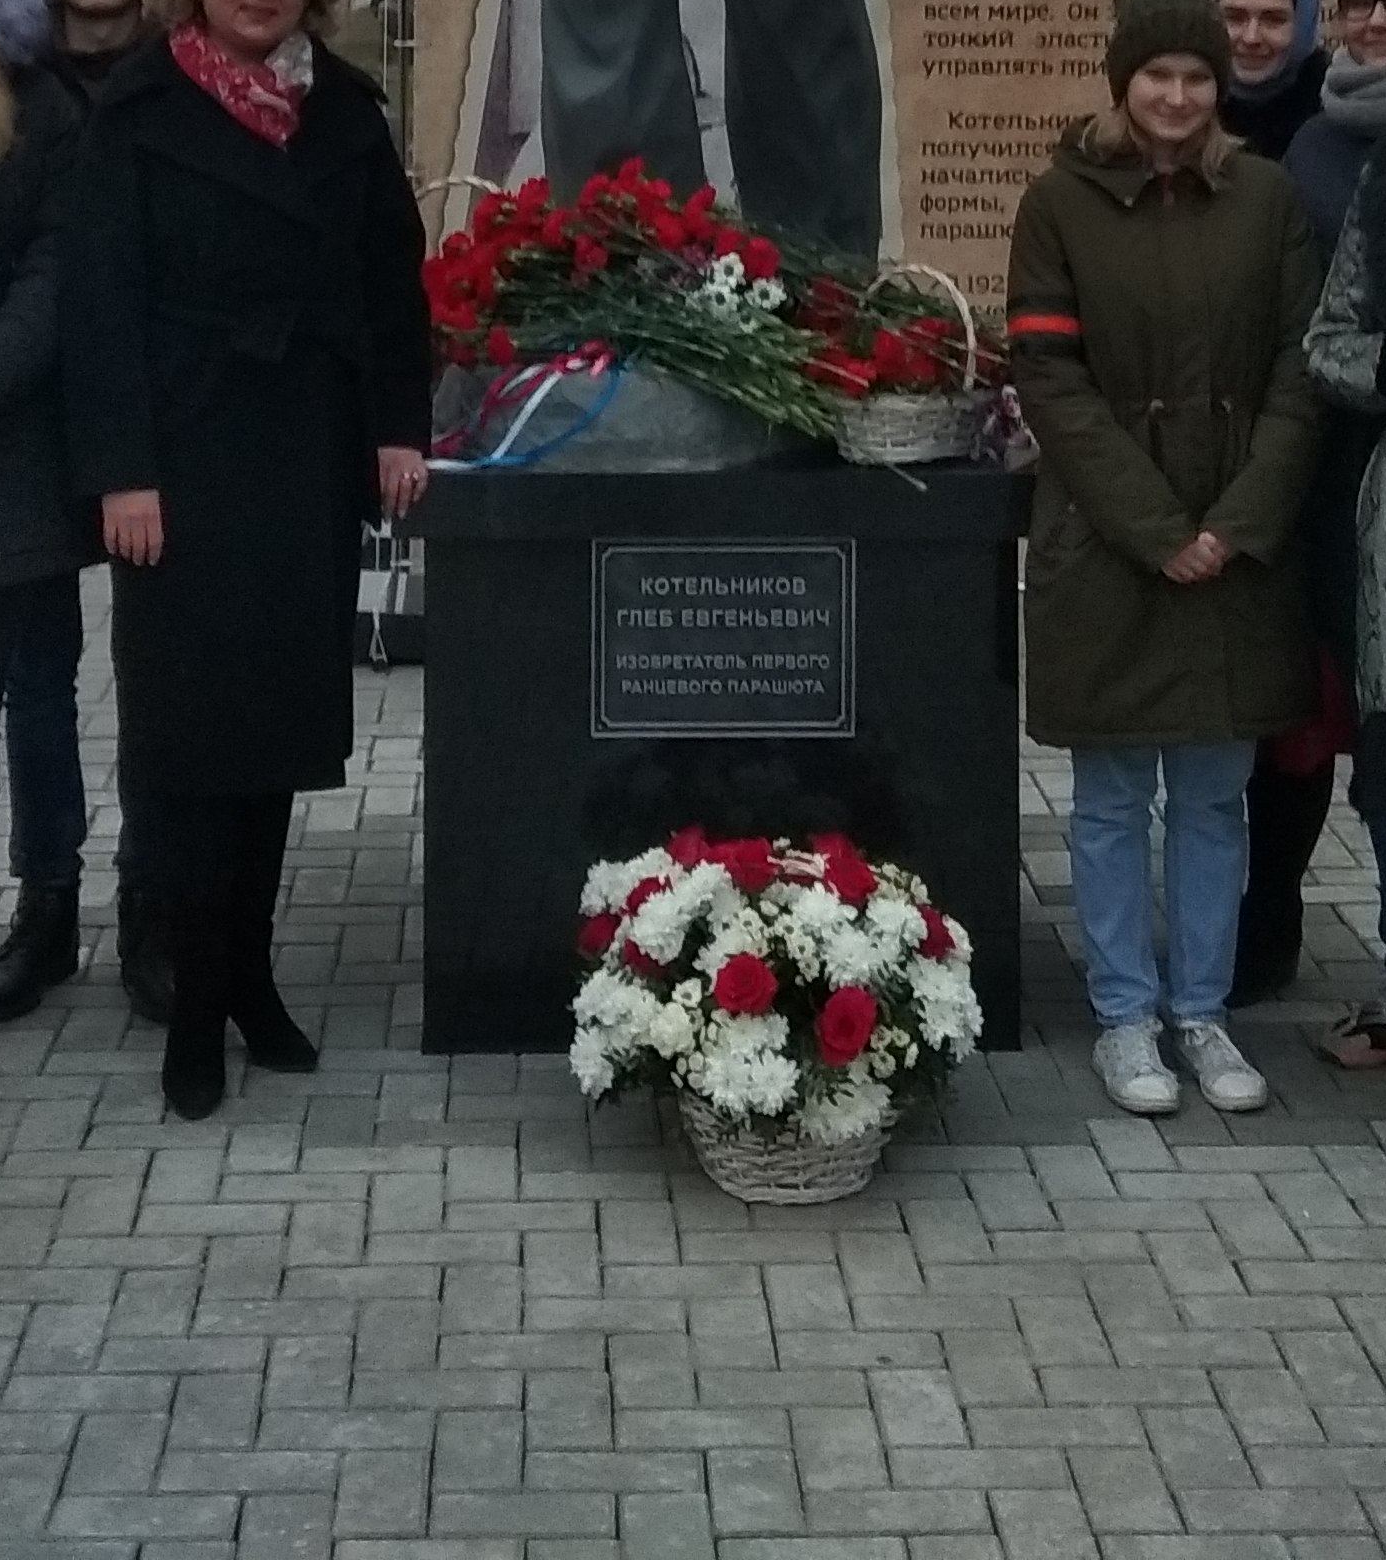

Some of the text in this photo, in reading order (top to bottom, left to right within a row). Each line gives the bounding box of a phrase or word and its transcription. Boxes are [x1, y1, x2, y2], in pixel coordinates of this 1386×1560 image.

[924, 3, 980, 21] всем
[1068, 1, 1098, 21] Он
[923, 27, 1014, 49] тонкий
[922, 57, 1053, 79] управлять
[920, 193, 1005, 216] формы,
[640, 576, 807, 596] КОТЕЛЬНИКОВ
[616, 608, 831, 628] ГЛЕБ ЕВГЕНЬЕВИЧ
[616, 653, 831, 671] ИЗОБРЕТАТЕЛЬ ПЕРВОГО
[621, 678, 826, 696] РАНЦЕВОГО ПАРАШЮТА
